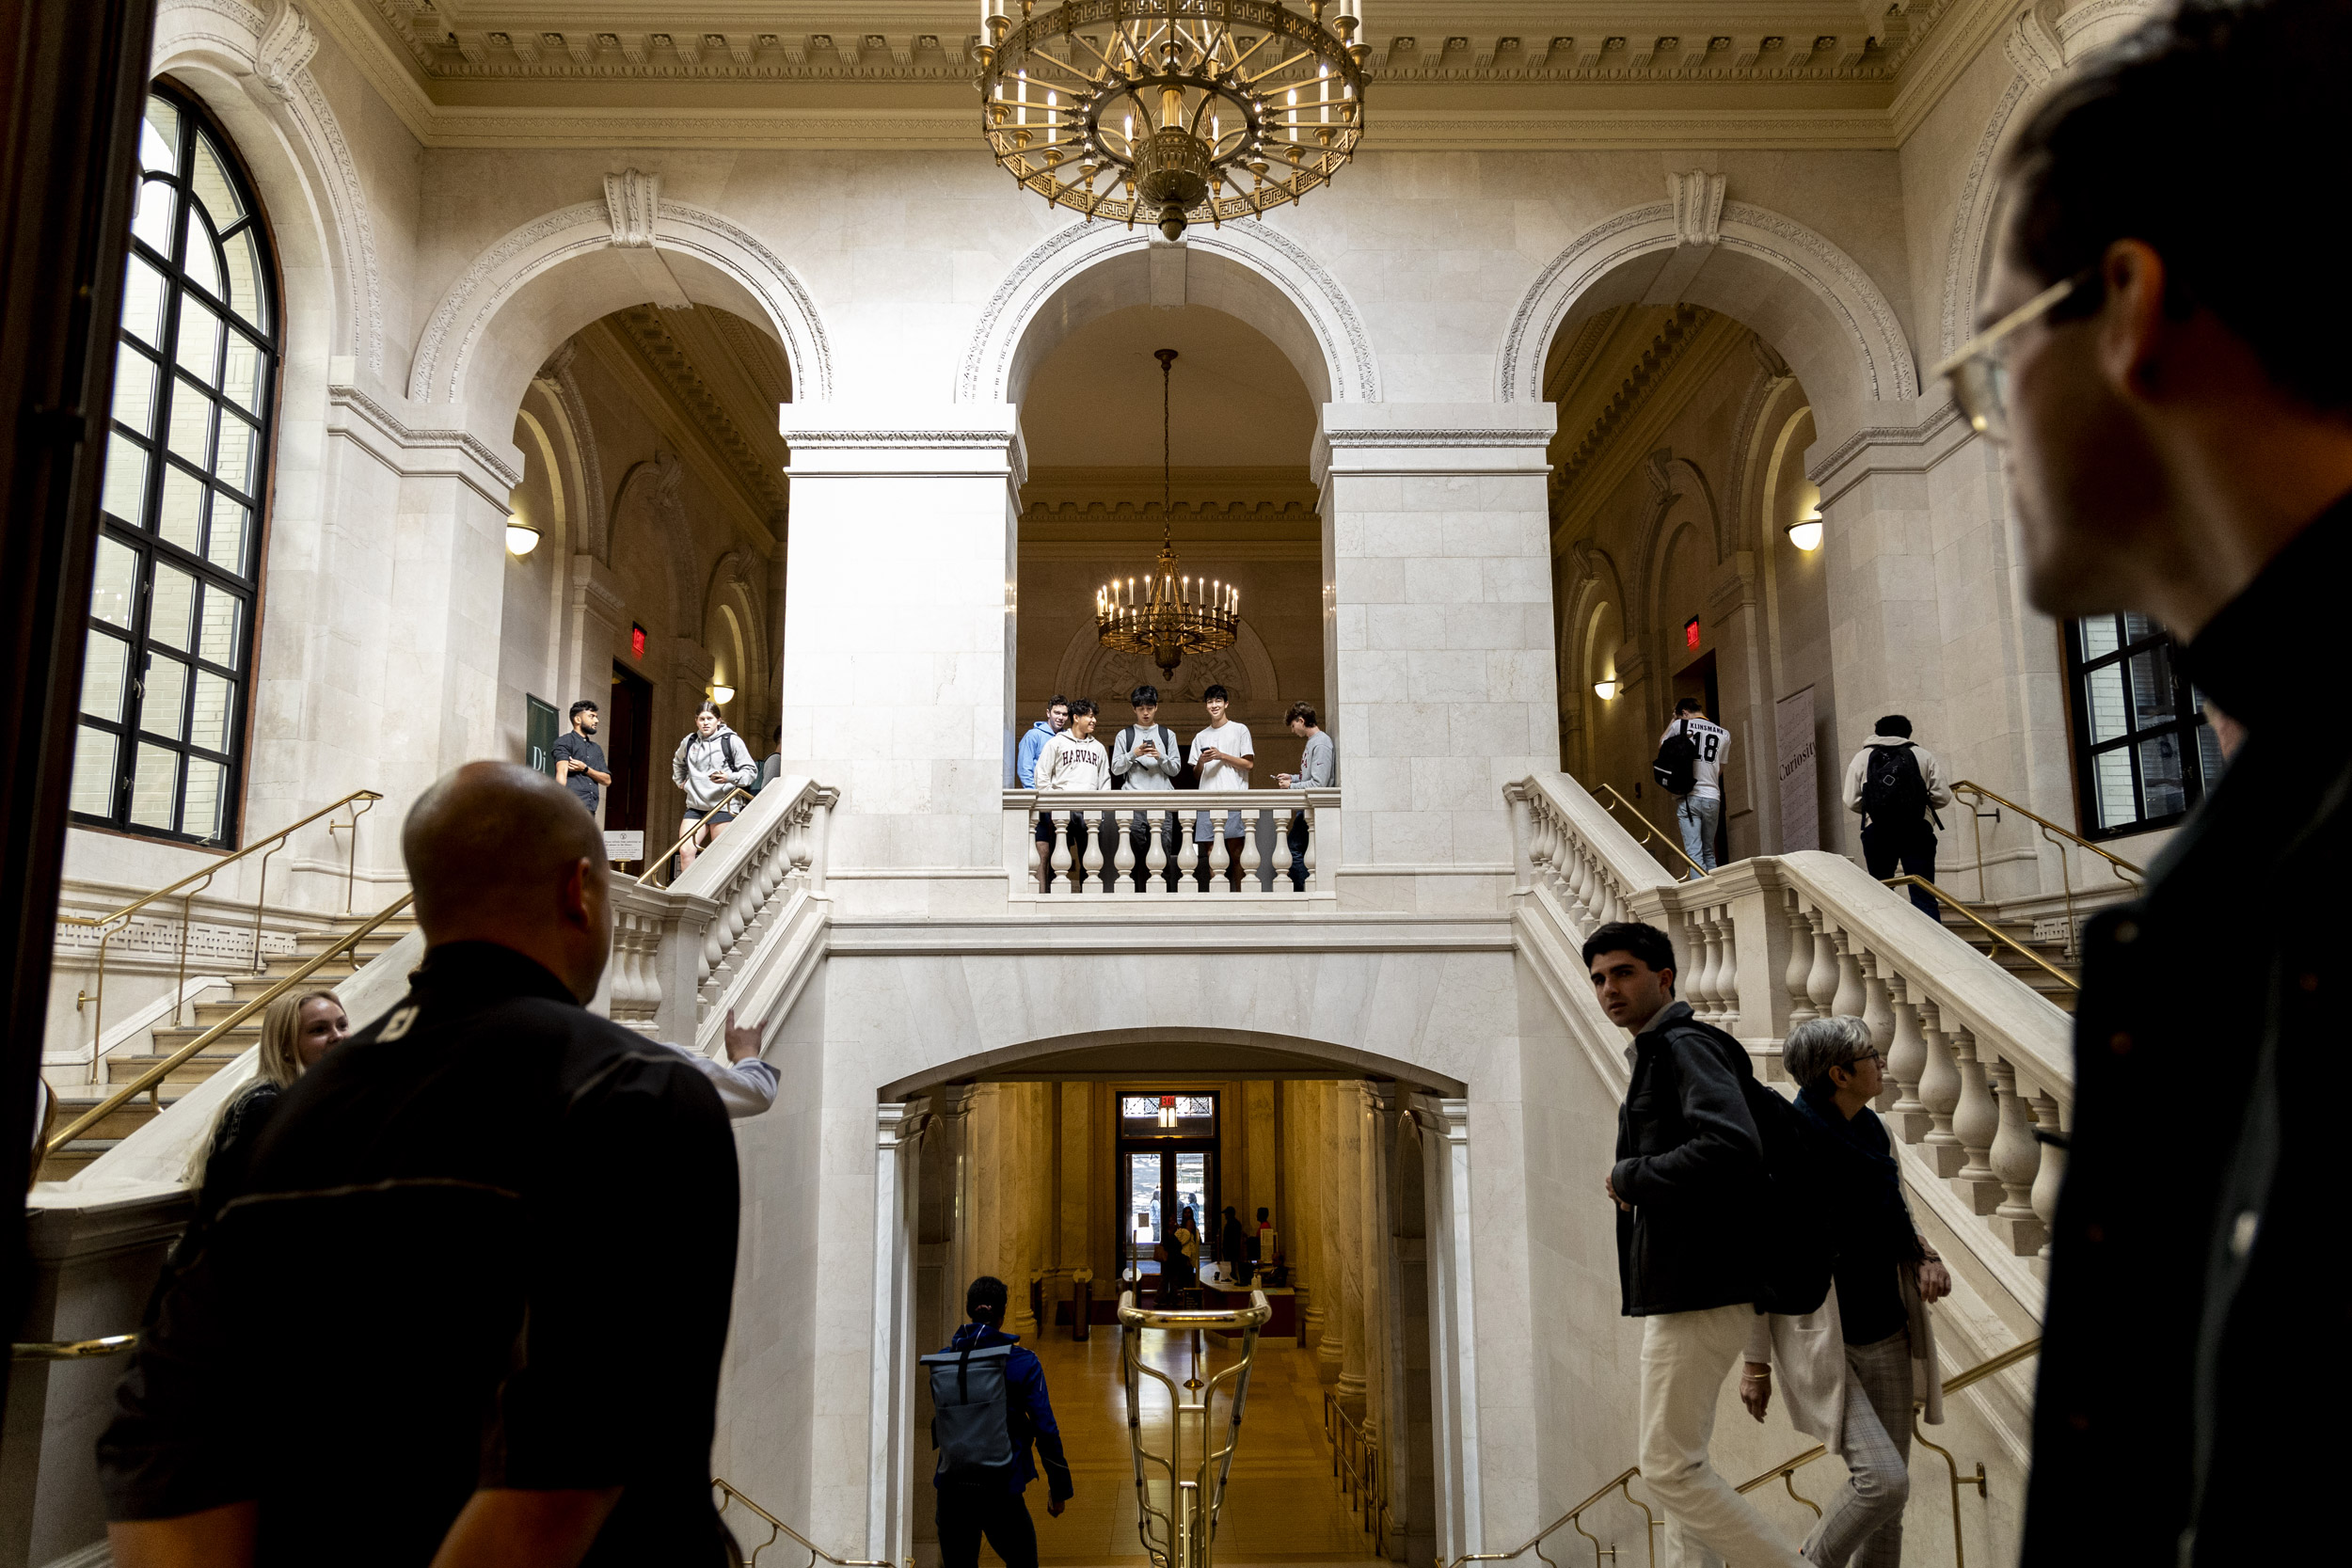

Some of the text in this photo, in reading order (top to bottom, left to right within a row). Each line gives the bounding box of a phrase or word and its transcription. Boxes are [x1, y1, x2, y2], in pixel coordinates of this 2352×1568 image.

[1690, 722, 1724, 735] KLINSMANN
[1692, 732, 1720, 763] 18
[1062, 749, 1100, 767] HARVAR
[1161, 1095, 1175, 1106] EXIT
